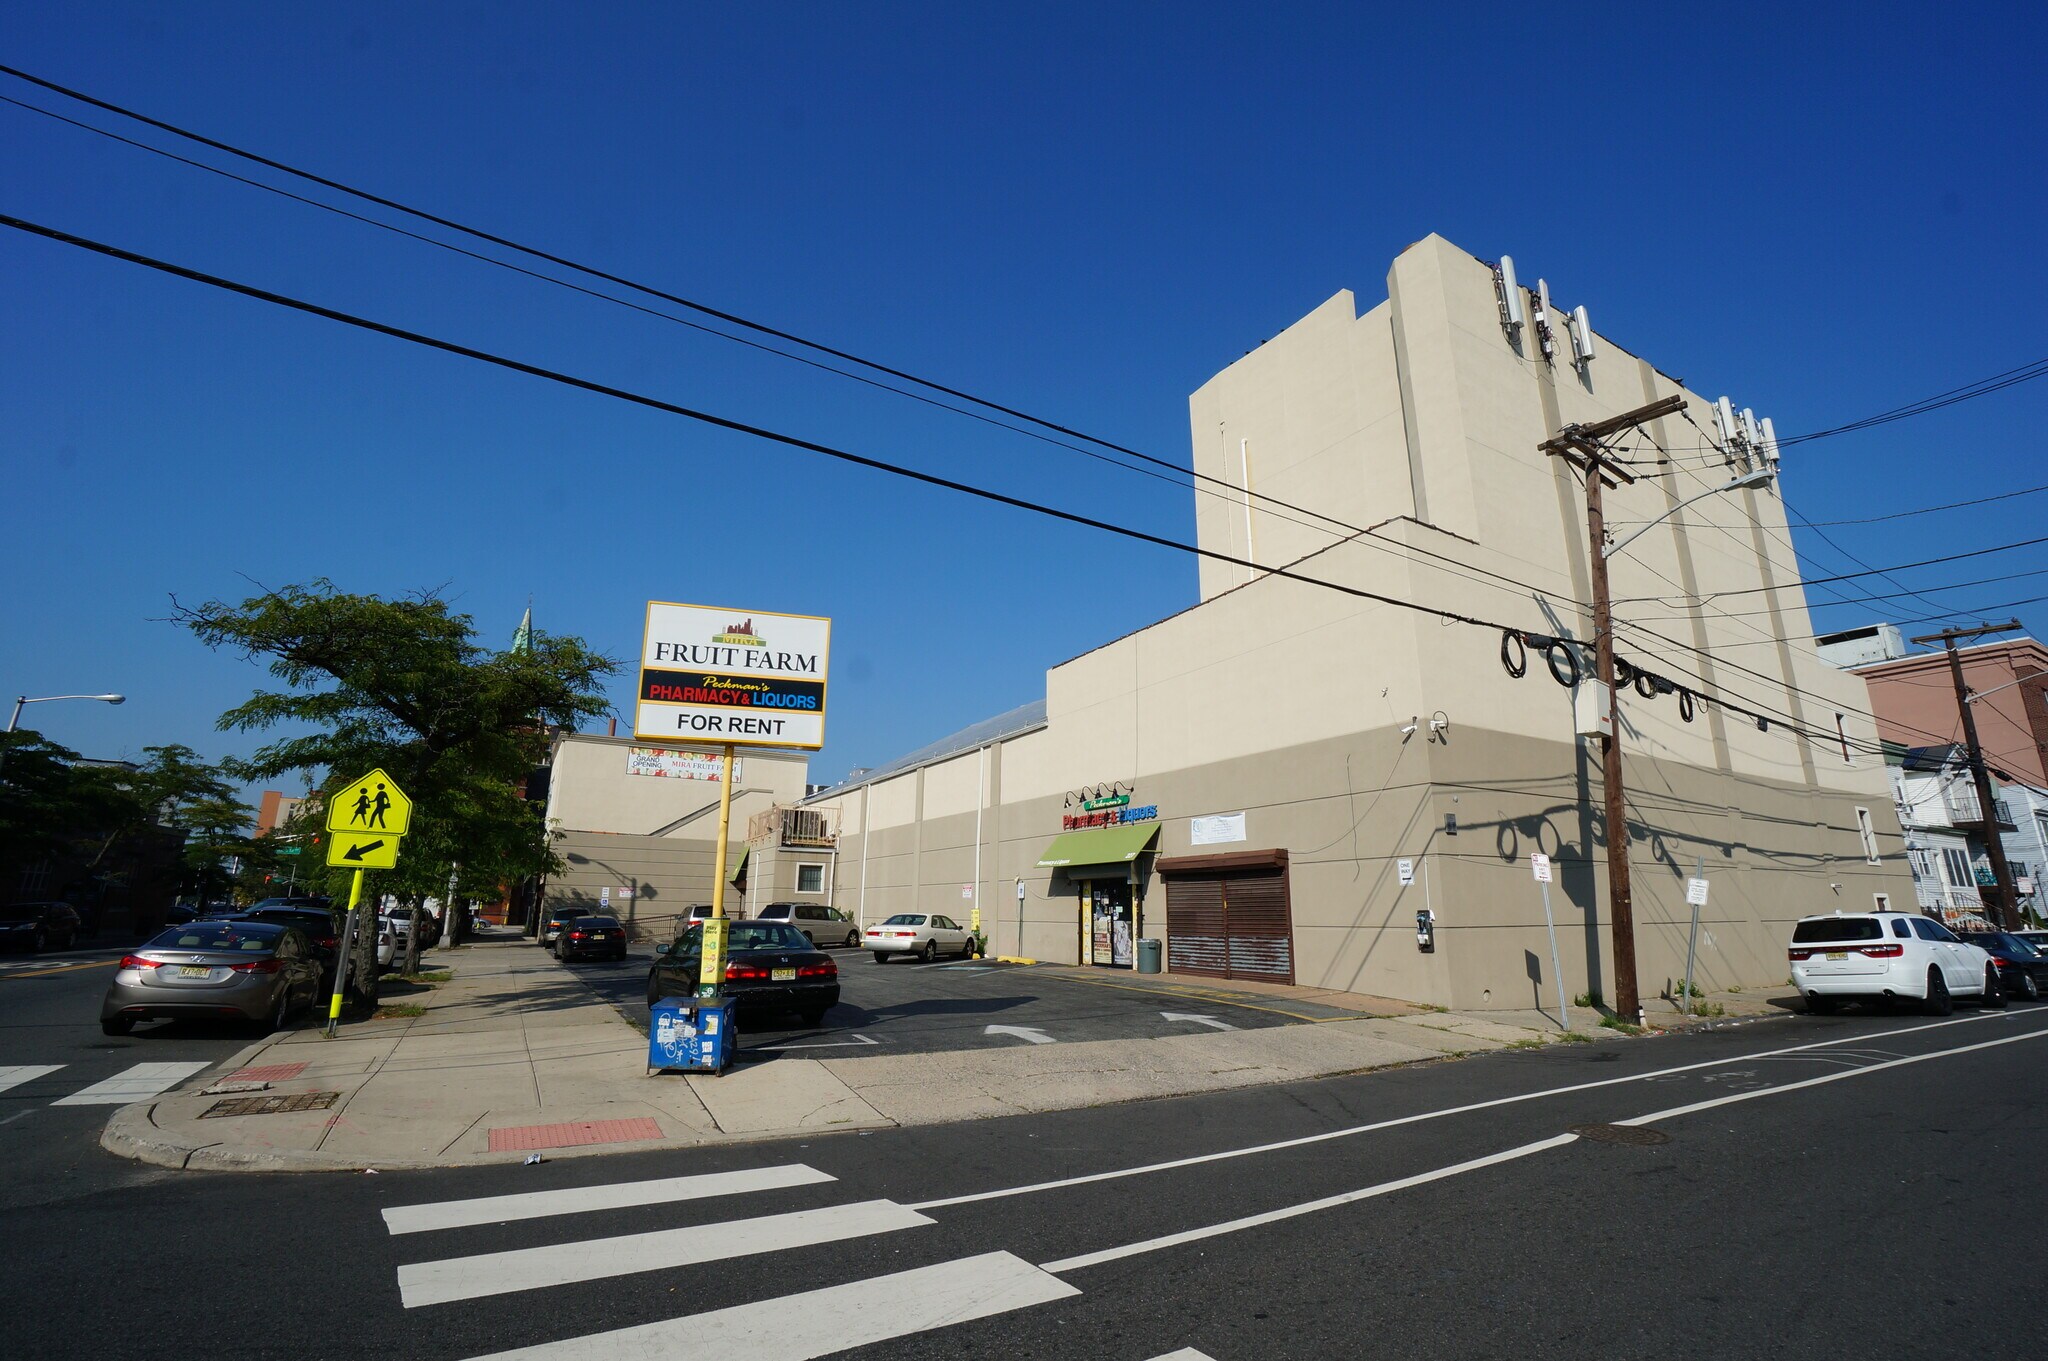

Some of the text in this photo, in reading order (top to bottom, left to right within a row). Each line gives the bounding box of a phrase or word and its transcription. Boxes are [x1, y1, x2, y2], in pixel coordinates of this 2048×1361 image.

[723, 634, 758, 646] MIRA
[654, 642, 818, 673] FRUIT FARM
[702, 676, 770, 692] Peckman's
[752, 692, 816, 709] LIQUORS
[677, 714, 785, 735] FOR RENT
[632, 760, 663, 769] OPENING
[636, 755, 660, 763] GRAND
[671, 761, 691, 769] MIRA
[692, 763, 715, 771] FRUIT
[1063, 812, 1108, 830] Pharmacy
[1118, 804, 1158, 825] Liquors
